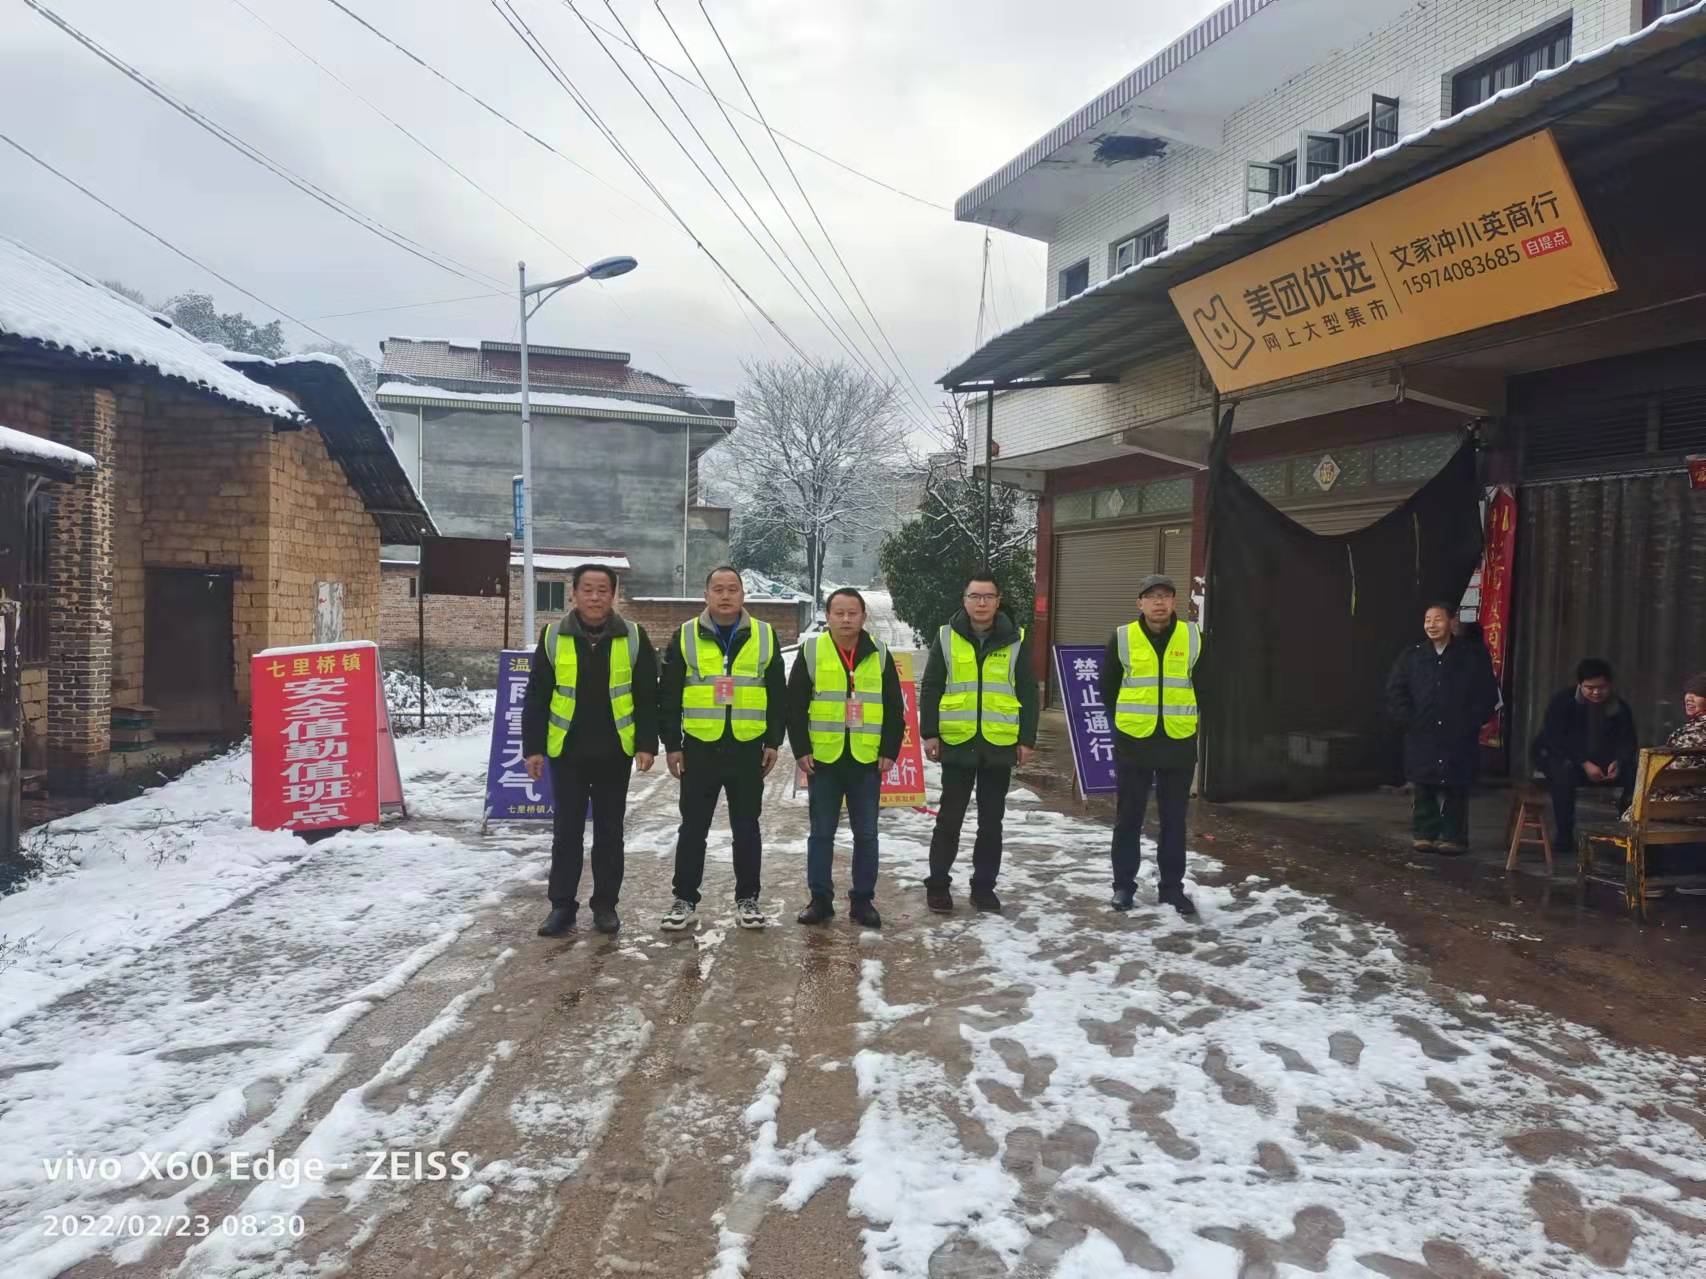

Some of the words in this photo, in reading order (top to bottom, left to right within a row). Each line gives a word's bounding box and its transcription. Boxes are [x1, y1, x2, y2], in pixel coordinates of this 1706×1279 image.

[1390, 190, 1559, 272] 文家冲小英商行
[1526, 231, 1569, 256] 自提点
[1243, 249, 1376, 327] 美团优选
[1402, 244, 1520, 295] 15974083685
[1262, 298, 1389, 352] 网上大型集市
[266, 653, 361, 678] 七里桥镇
[1073, 657, 1115, 761] 禁止通行
[280, 677, 353, 826] 安全值勤值班点
